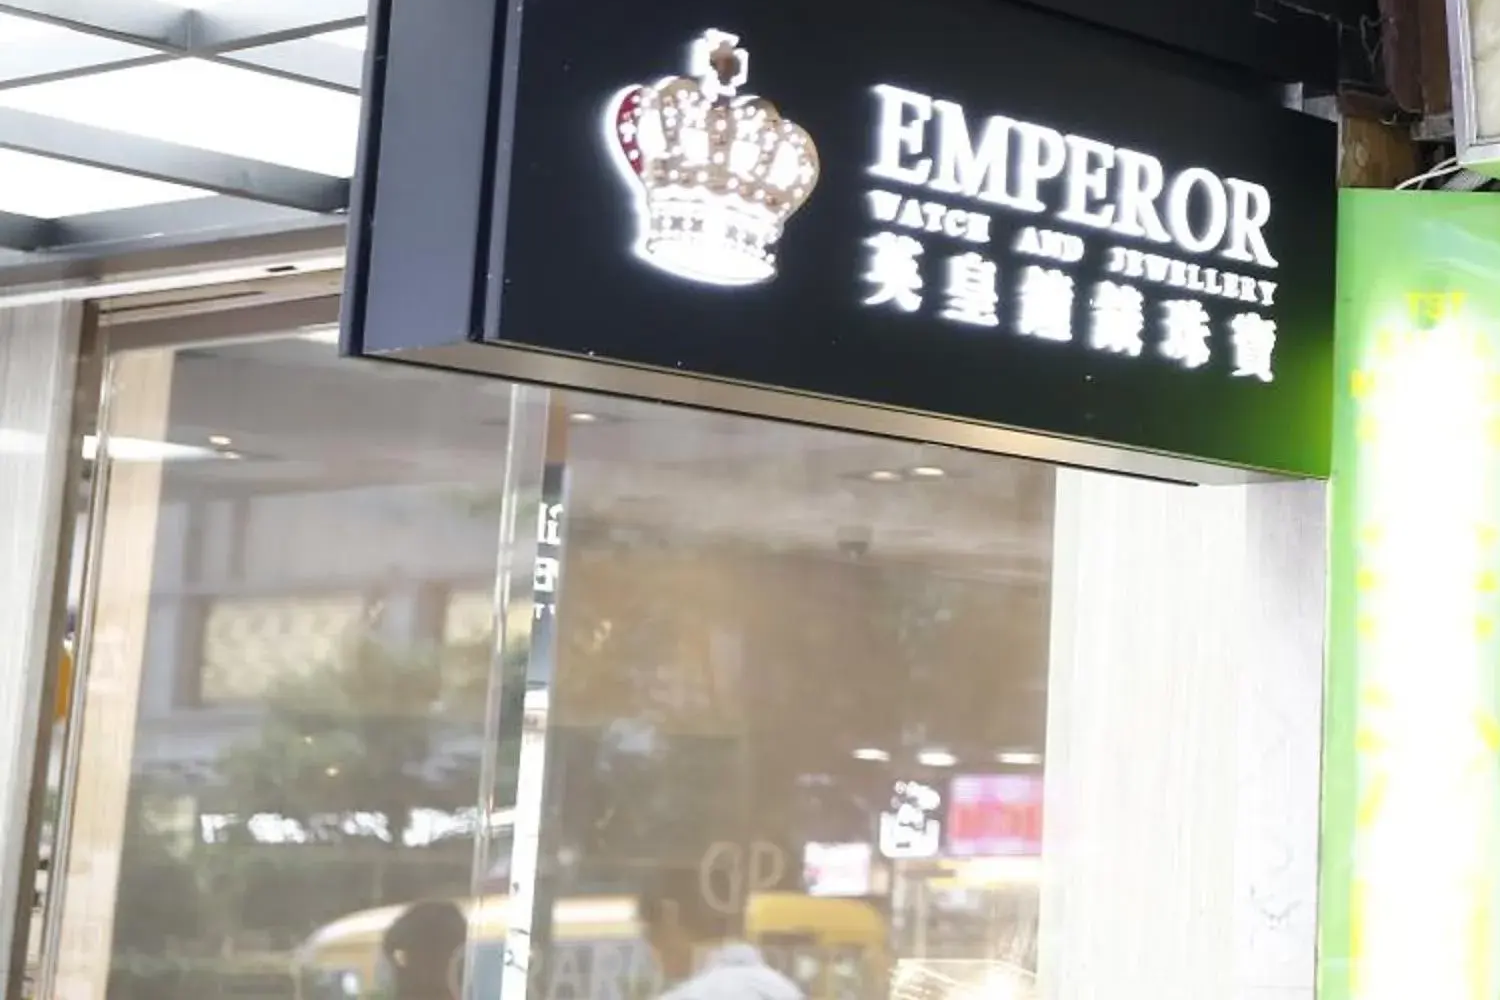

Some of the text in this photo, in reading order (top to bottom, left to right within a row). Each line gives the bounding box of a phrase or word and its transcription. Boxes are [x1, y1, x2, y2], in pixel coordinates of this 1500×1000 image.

[867, 83, 1279, 268] EMPEROR
[868, 190, 1278, 306] WATCH AND JEWELLERY
